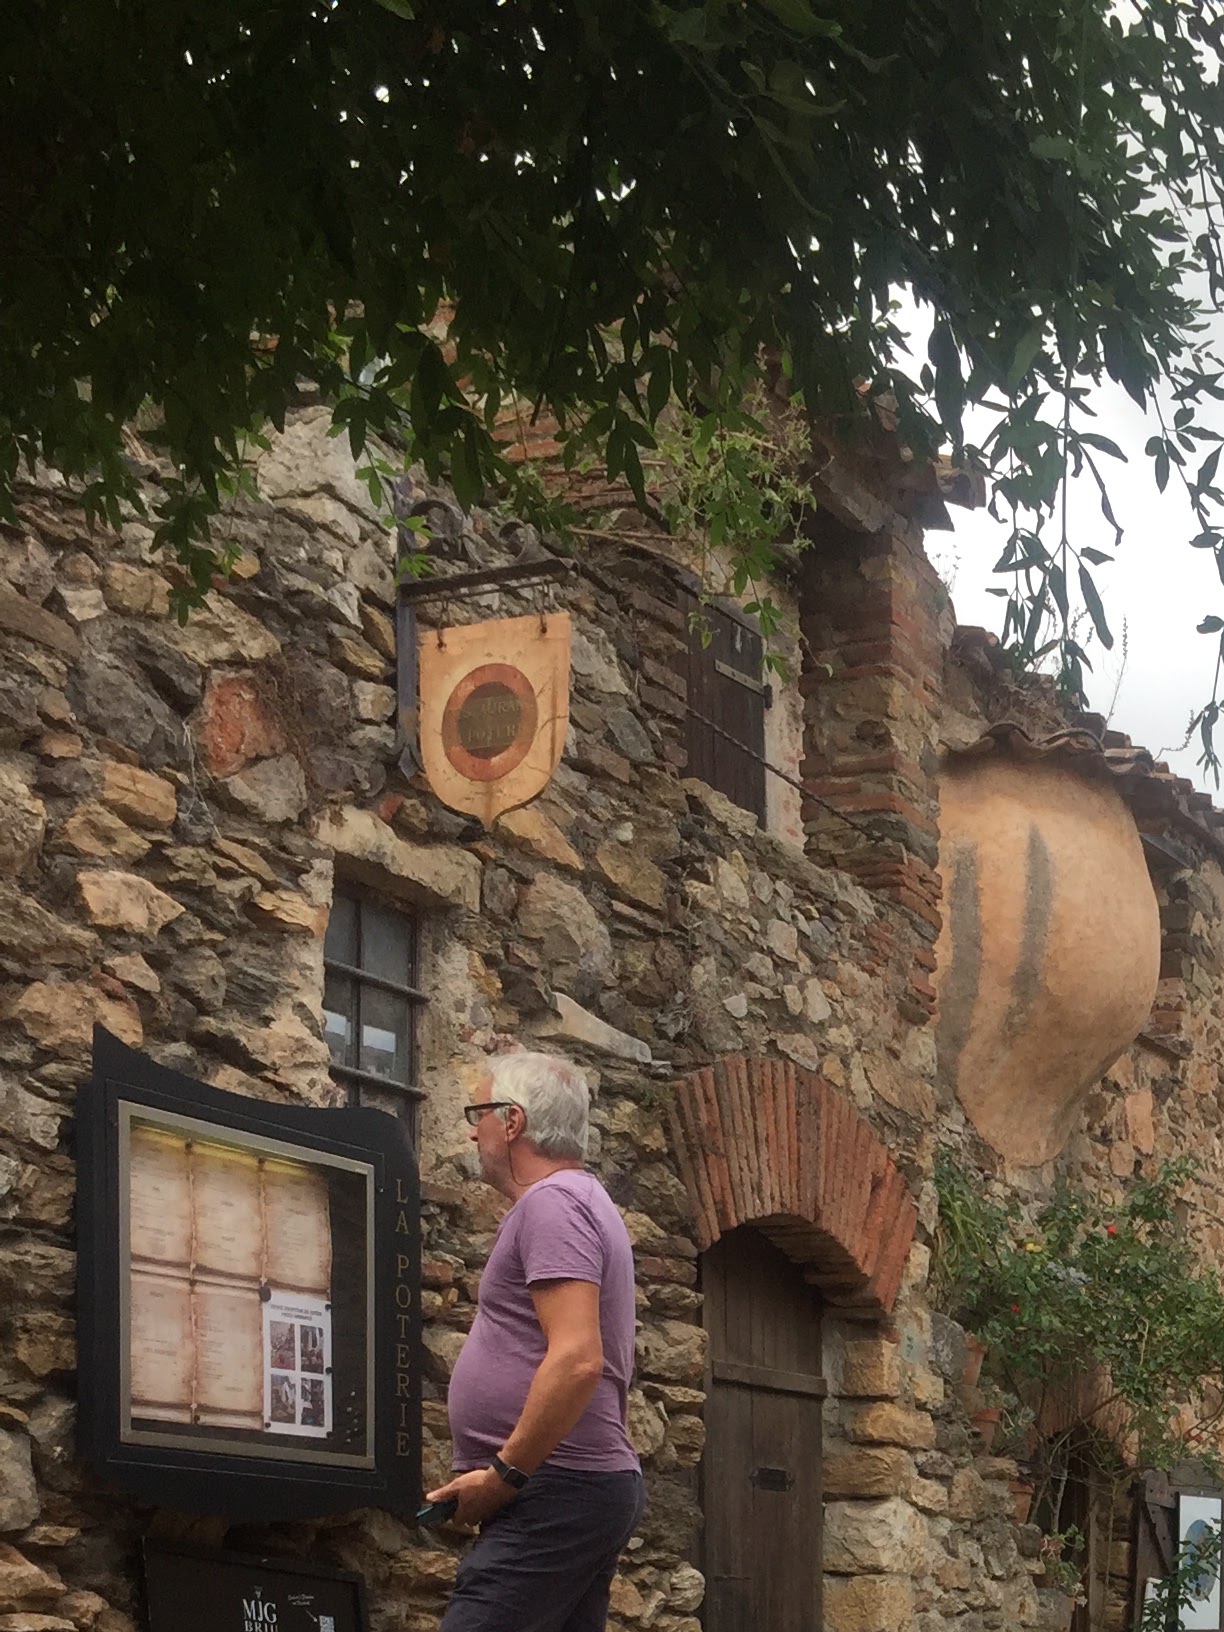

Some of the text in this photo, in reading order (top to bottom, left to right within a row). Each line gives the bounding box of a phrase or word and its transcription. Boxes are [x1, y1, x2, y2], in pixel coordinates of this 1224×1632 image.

[395, 1178, 411, 1457] LA POTERIE
[242, 1598, 277, 1623] MJG
